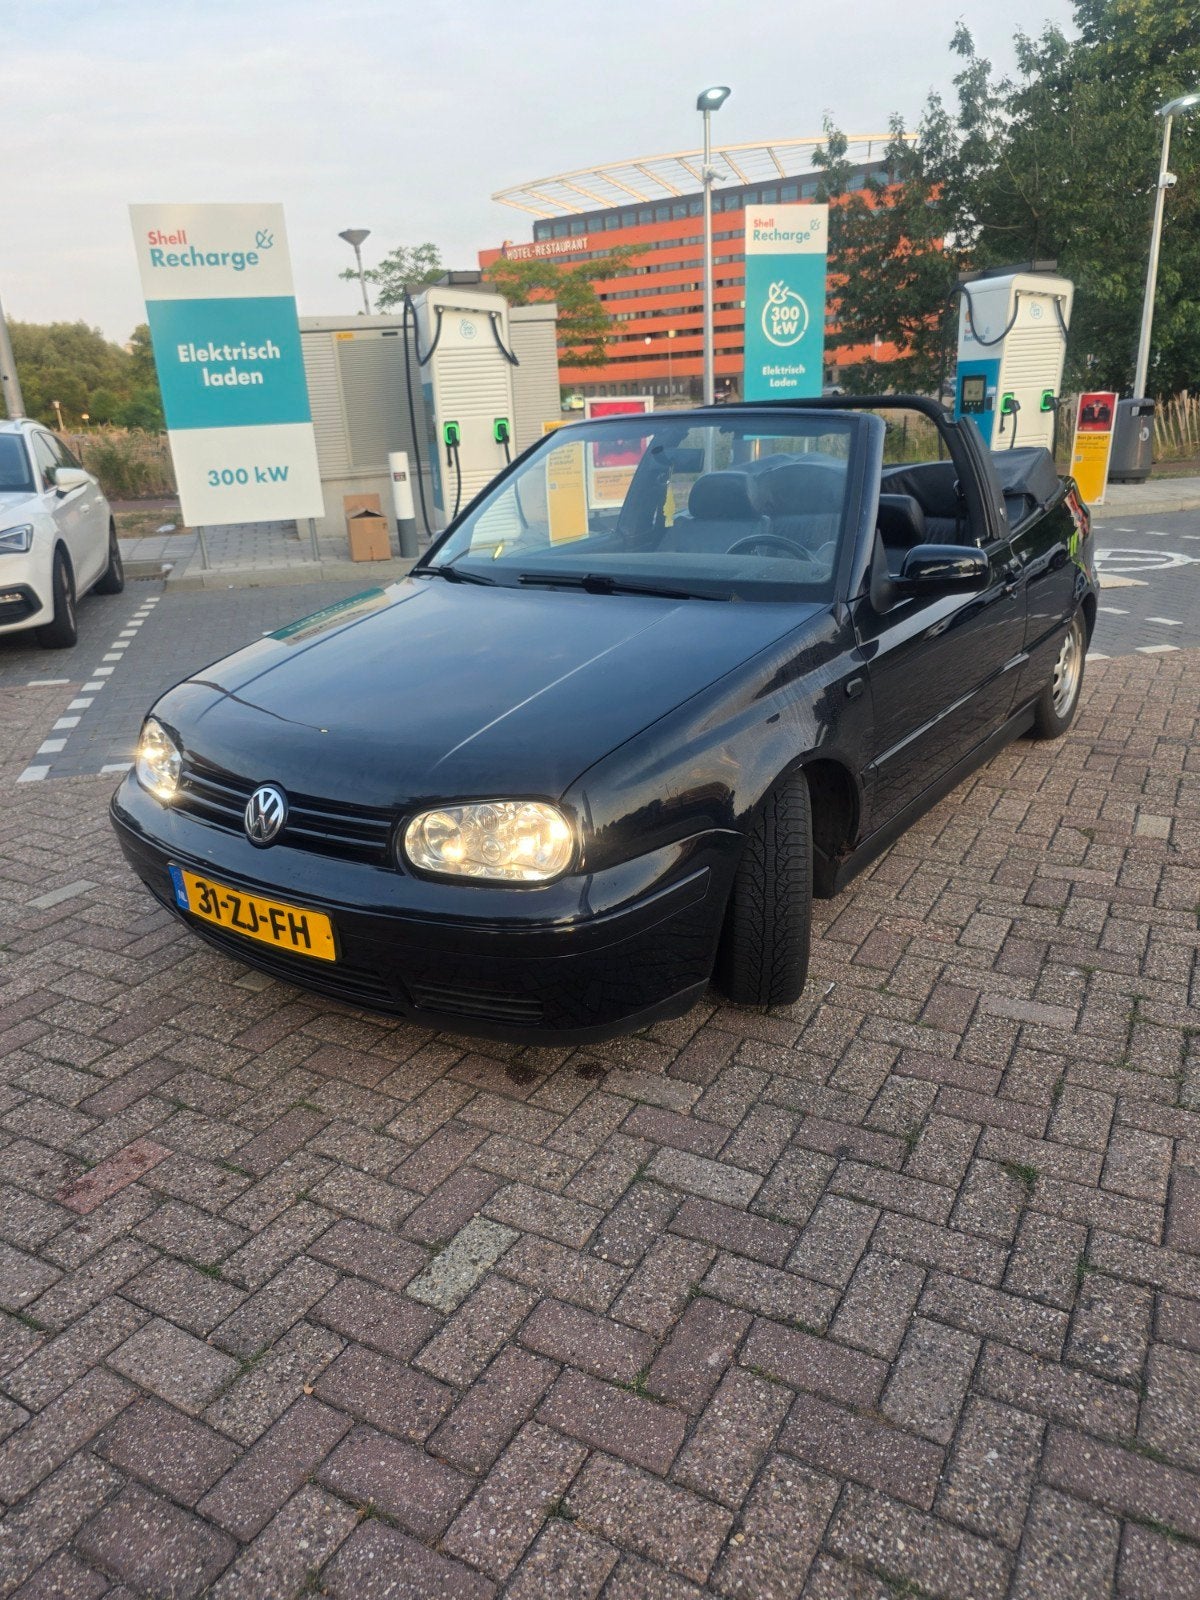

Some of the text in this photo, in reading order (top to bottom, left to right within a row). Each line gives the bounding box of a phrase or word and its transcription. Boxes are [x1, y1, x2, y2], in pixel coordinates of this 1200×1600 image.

[753, 218, 774, 229] Shell
[148, 230, 187, 246] Shell
[753, 228, 811, 244] Recharge
[507, 238, 588, 260] HOTEL-RESTAURANT
[150, 247, 260, 271] Recharge
[771, 306, 800, 321] 300
[772, 321, 798, 335] kW
[177, 340, 280, 363] Elektrisch
[203, 367, 264, 386] laden
[762, 364, 806, 376] Elektrisch
[769, 375, 797, 388] Laden
[208, 466, 289, 486] 300 kW
[195, 881, 312, 949] 31-ZJ-FH
